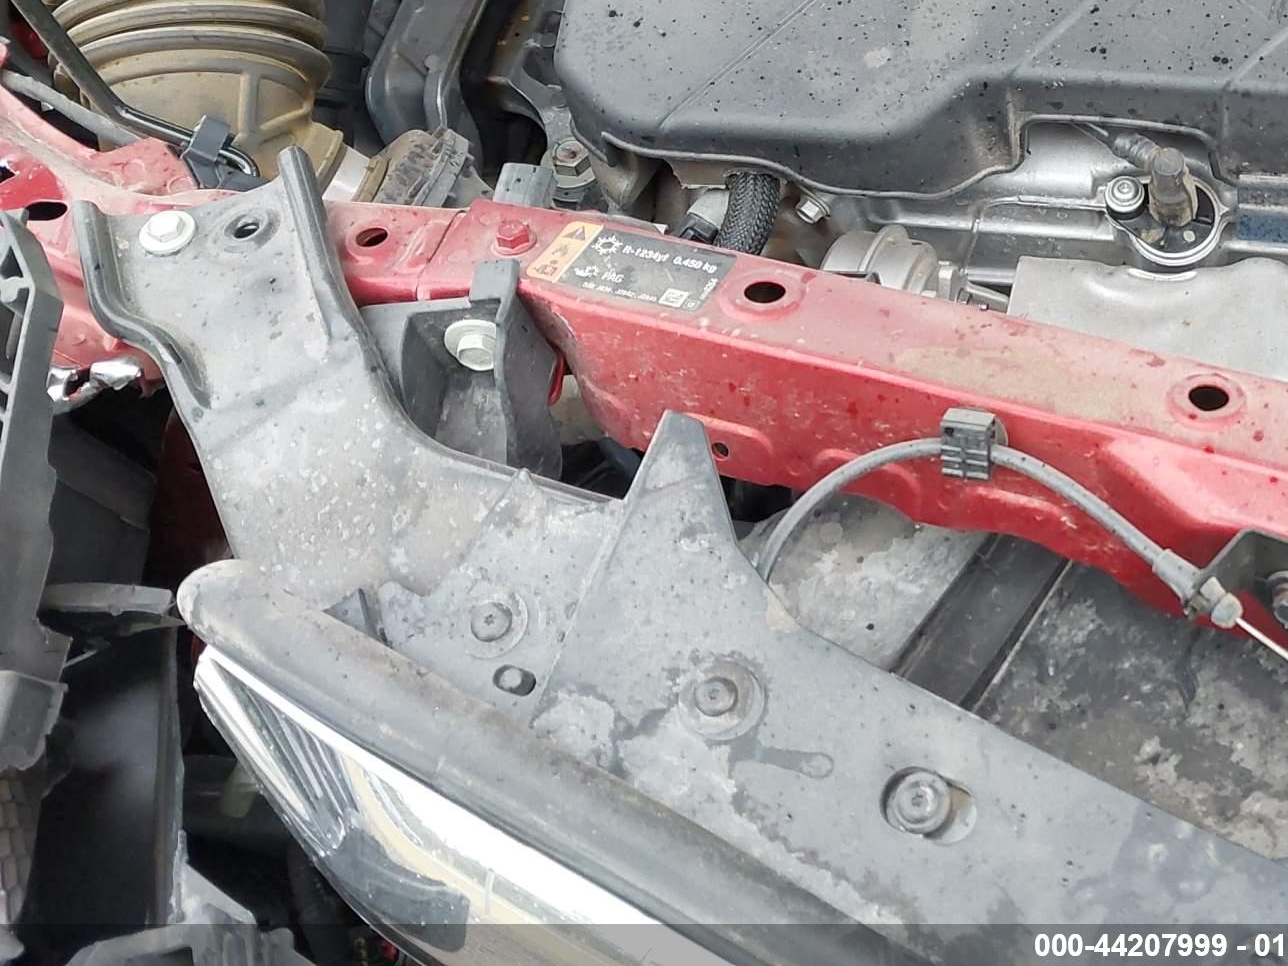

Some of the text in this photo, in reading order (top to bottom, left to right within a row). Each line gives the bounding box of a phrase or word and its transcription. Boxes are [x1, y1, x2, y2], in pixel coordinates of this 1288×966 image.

[622, 244, 670, 263] R-1234yf
[673, 256, 702, 269] 0.450
[601, 271, 625, 284] PAG
